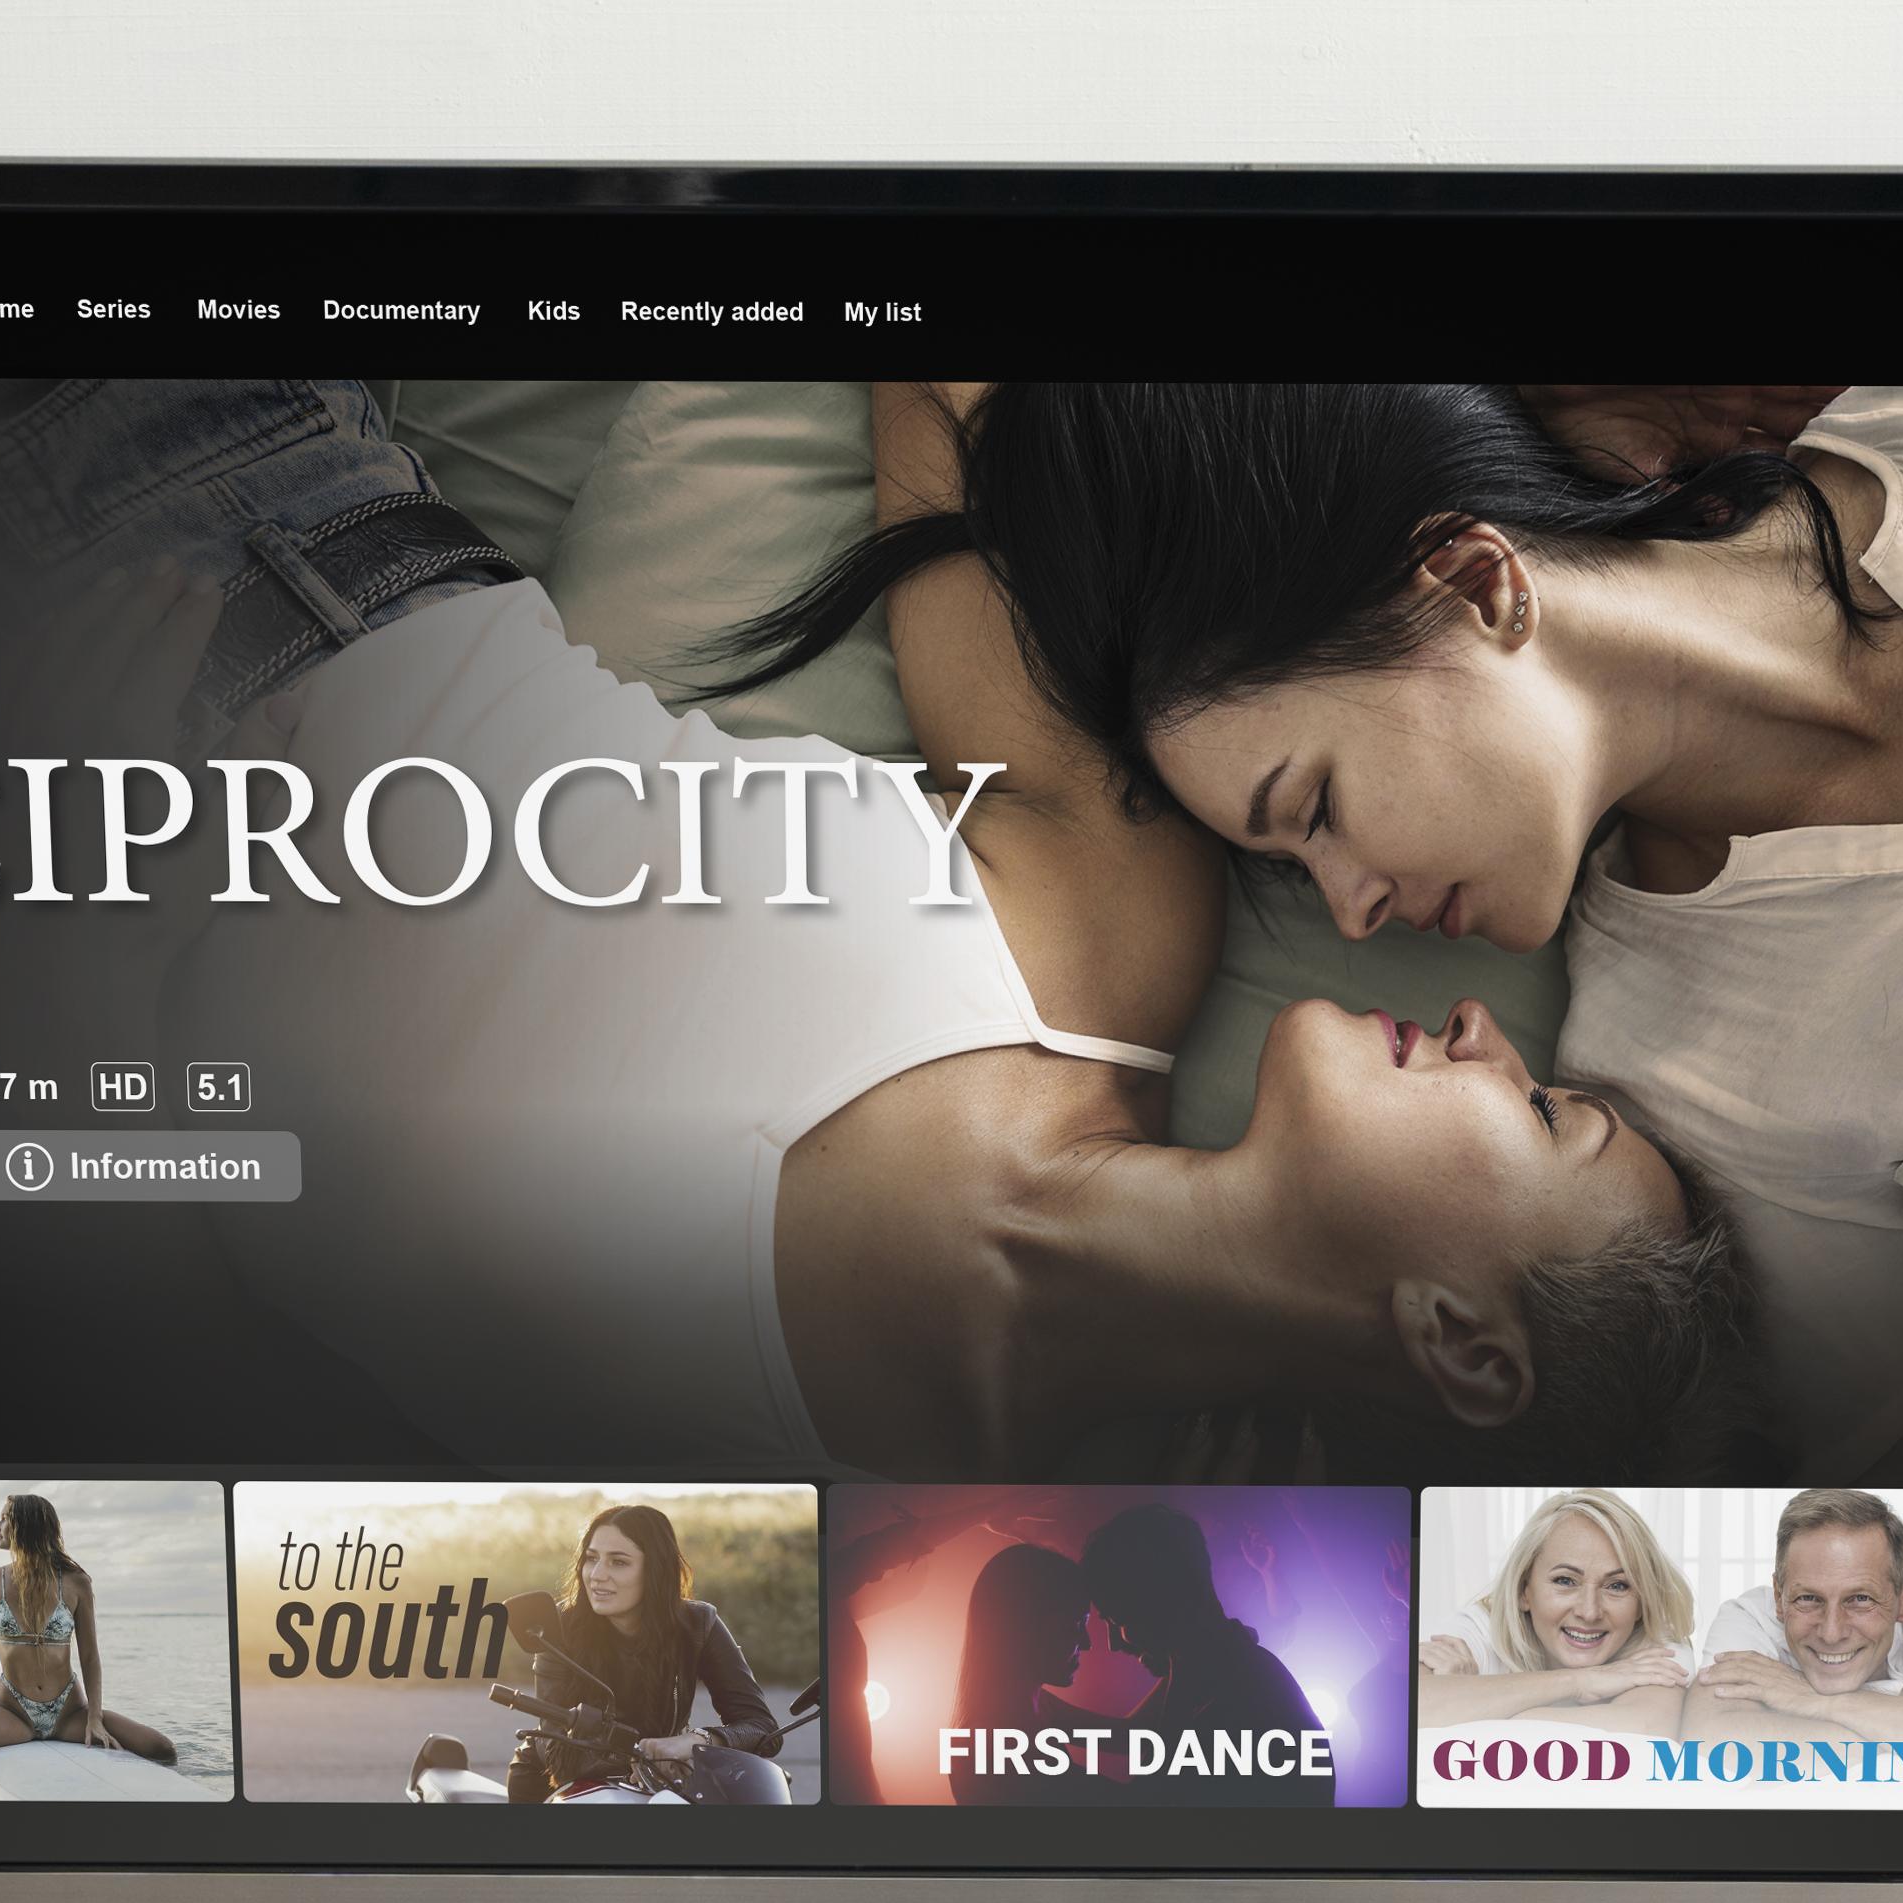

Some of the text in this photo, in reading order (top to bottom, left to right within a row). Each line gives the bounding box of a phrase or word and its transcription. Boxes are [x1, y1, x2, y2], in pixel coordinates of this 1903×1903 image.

[77, 298, 151, 319] Series
[198, 299, 281, 320] Movies
[323, 299, 481, 326] Documentary
[528, 300, 581, 321] Kids
[621, 301, 804, 327] Recently added
[845, 301, 922, 327] My list
[28, 1079, 58, 1100] m
[99, 1072, 148, 1101] HD
[197, 1073, 241, 1101] 5.1
[71, 1151, 261, 1180] Information
[278, 1526, 404, 1591] to the
[268, 1577, 509, 1680] south
[938, 1727, 1334, 1777] FIRST DANCE
[1433, 1739, 1630, 1782] GOOD
